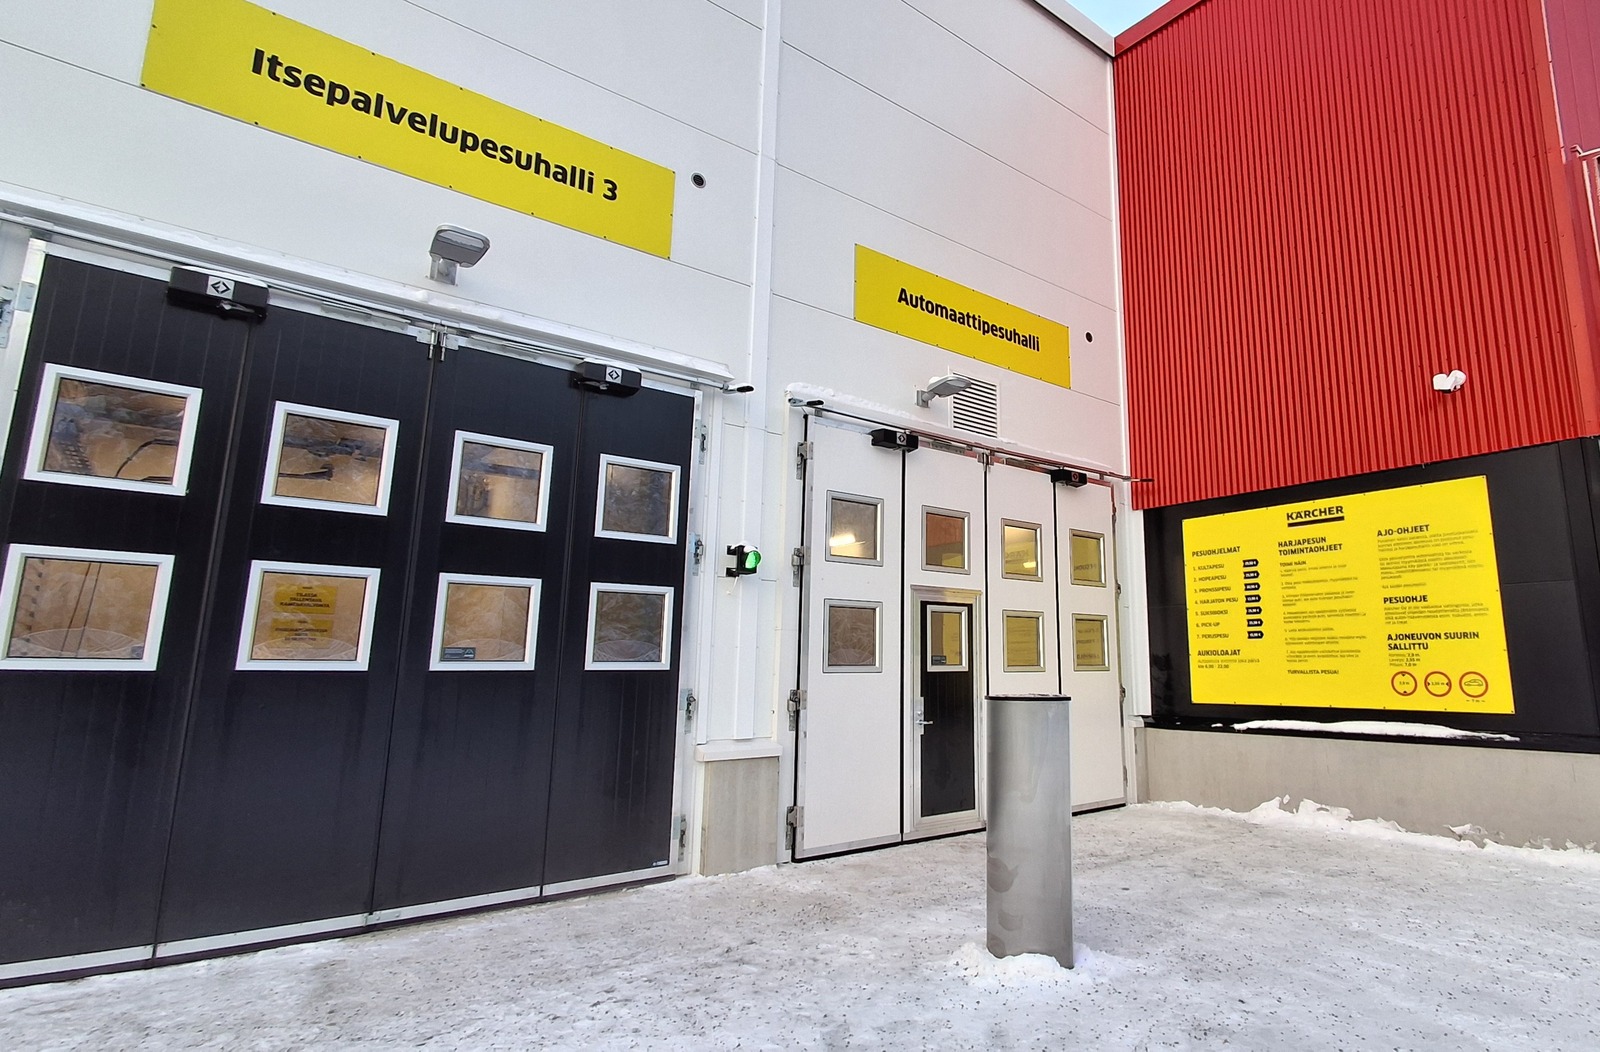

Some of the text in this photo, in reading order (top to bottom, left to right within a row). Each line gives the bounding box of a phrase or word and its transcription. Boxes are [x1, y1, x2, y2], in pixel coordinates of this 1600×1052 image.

[251, 48, 618, 201] Itsepalvelupesuhalli 3
[898, 287, 1040, 352] Automaattipesuhalli
[1286, 505, 1344, 521] KÄRCHER
[1377, 524, 1430, 537] AJO-OHJEET
[1278, 536, 1327, 548] HARJAPESUN
[1192, 546, 1241, 557] PESUOHJELMAT
[1278, 543, 1343, 556] TOIMINTAOHJEET
[1383, 595, 1428, 604] PESUOHJE
[1387, 633, 1442, 641] AJONEUVON
[1388, 642, 1429, 650] SALLITTU
